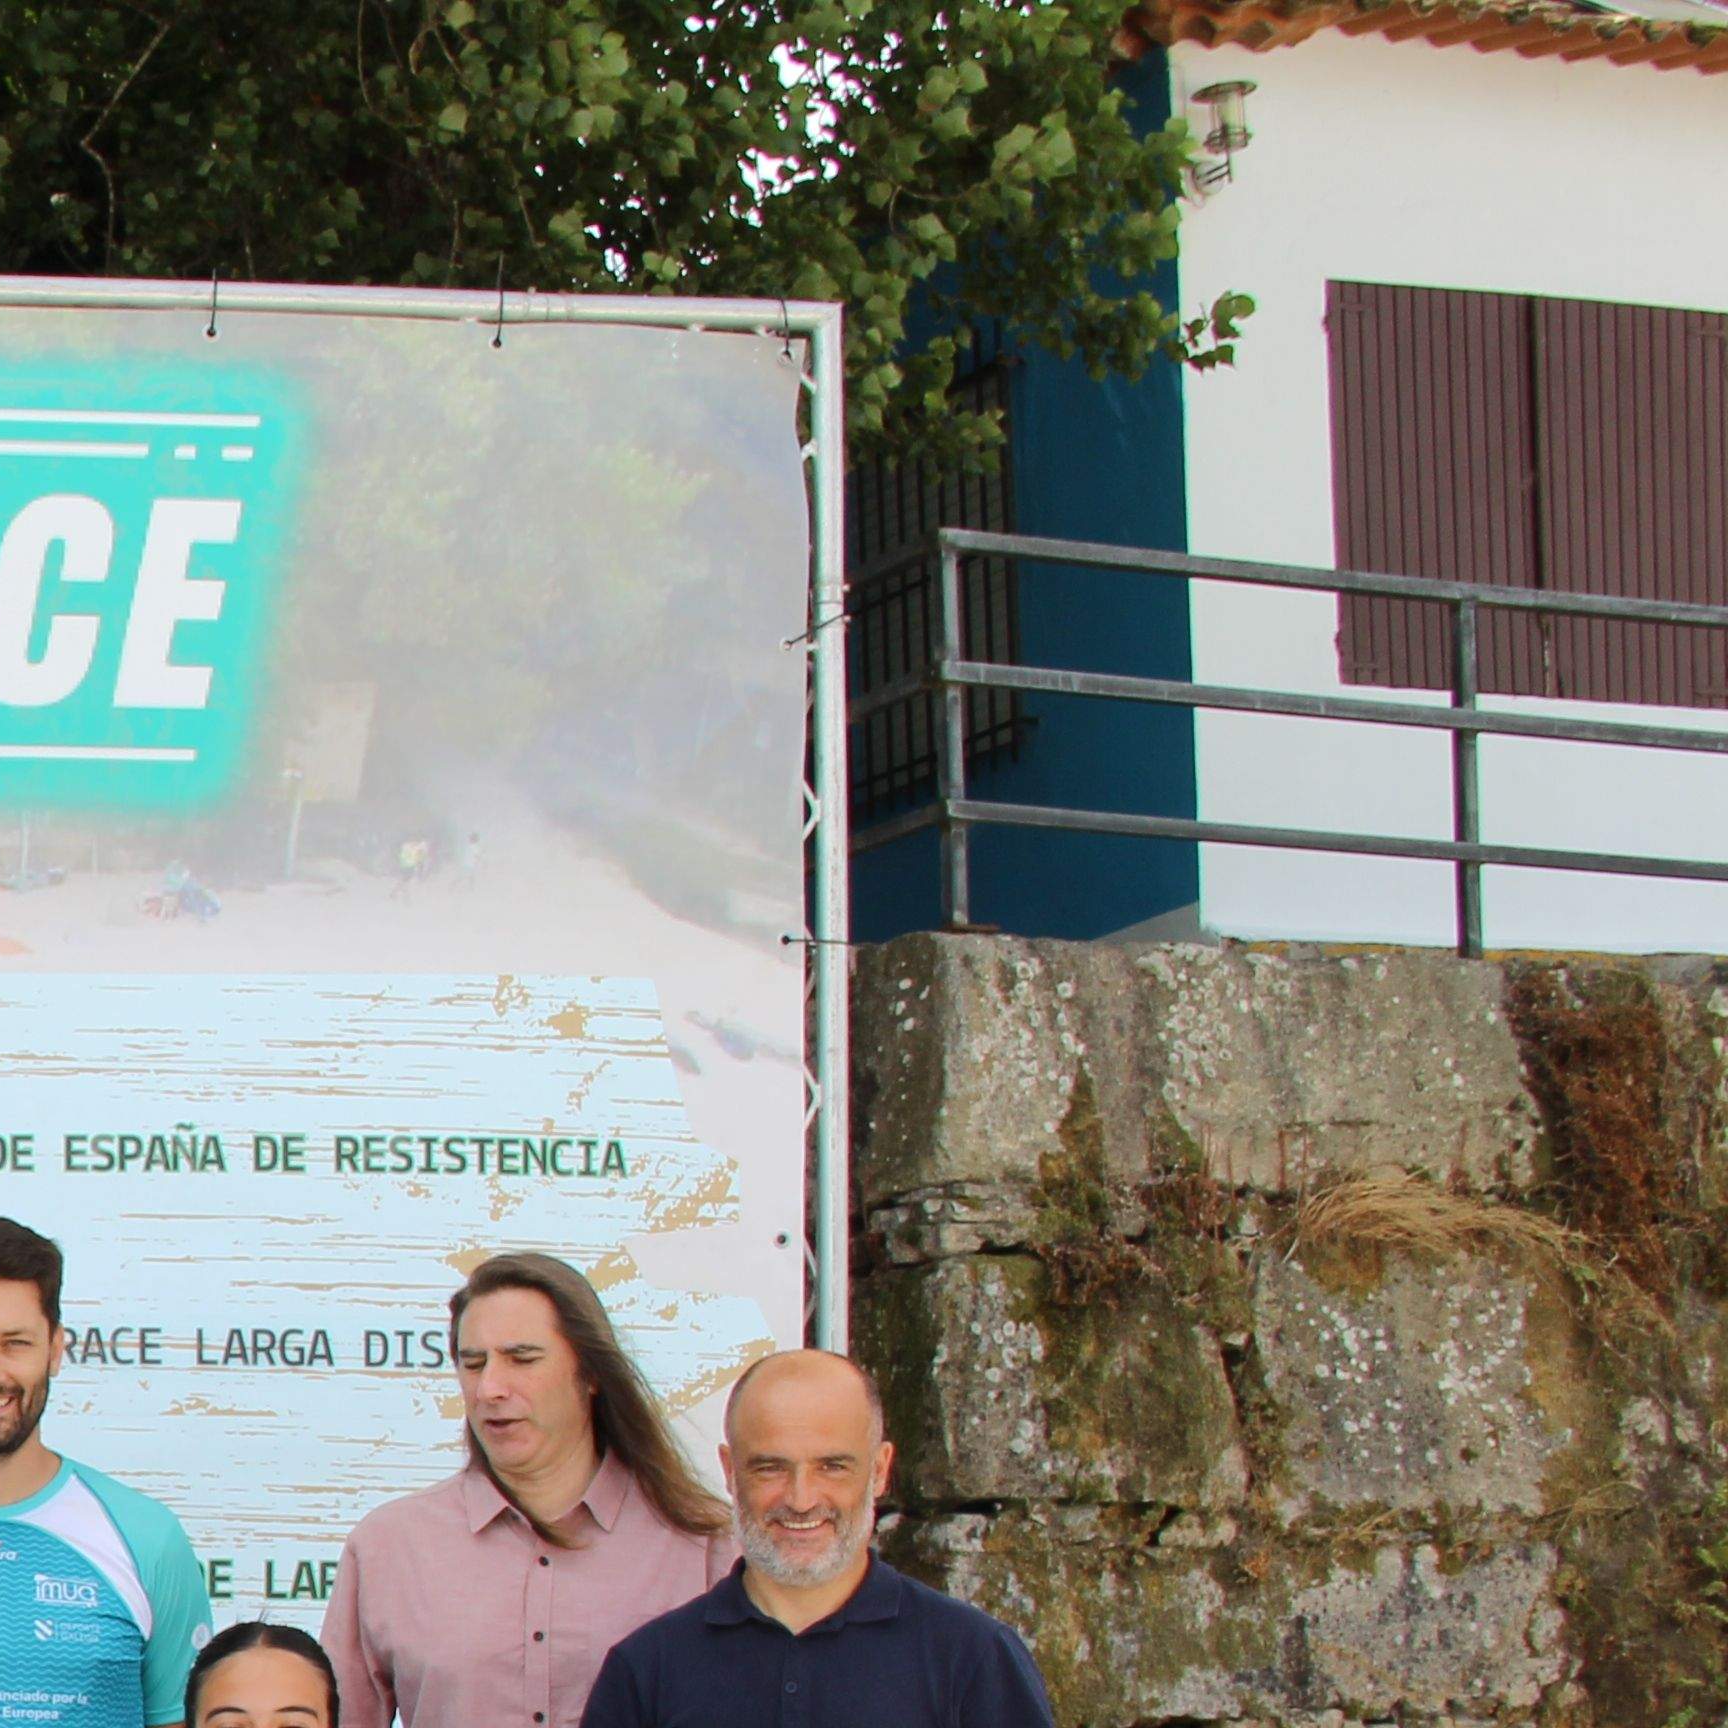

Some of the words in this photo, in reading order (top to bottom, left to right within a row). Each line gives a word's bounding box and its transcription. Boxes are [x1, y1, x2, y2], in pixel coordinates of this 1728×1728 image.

[64, 1121, 228, 1173] ESPAÑA
[252, 1133, 307, 1173] DE
[334, 1135, 628, 1179] RESISTENCIA
[195, 1328, 335, 1367] LARGA
[52, 1693, 76, 1706] por
[2, 1706, 60, 1722] Europea
